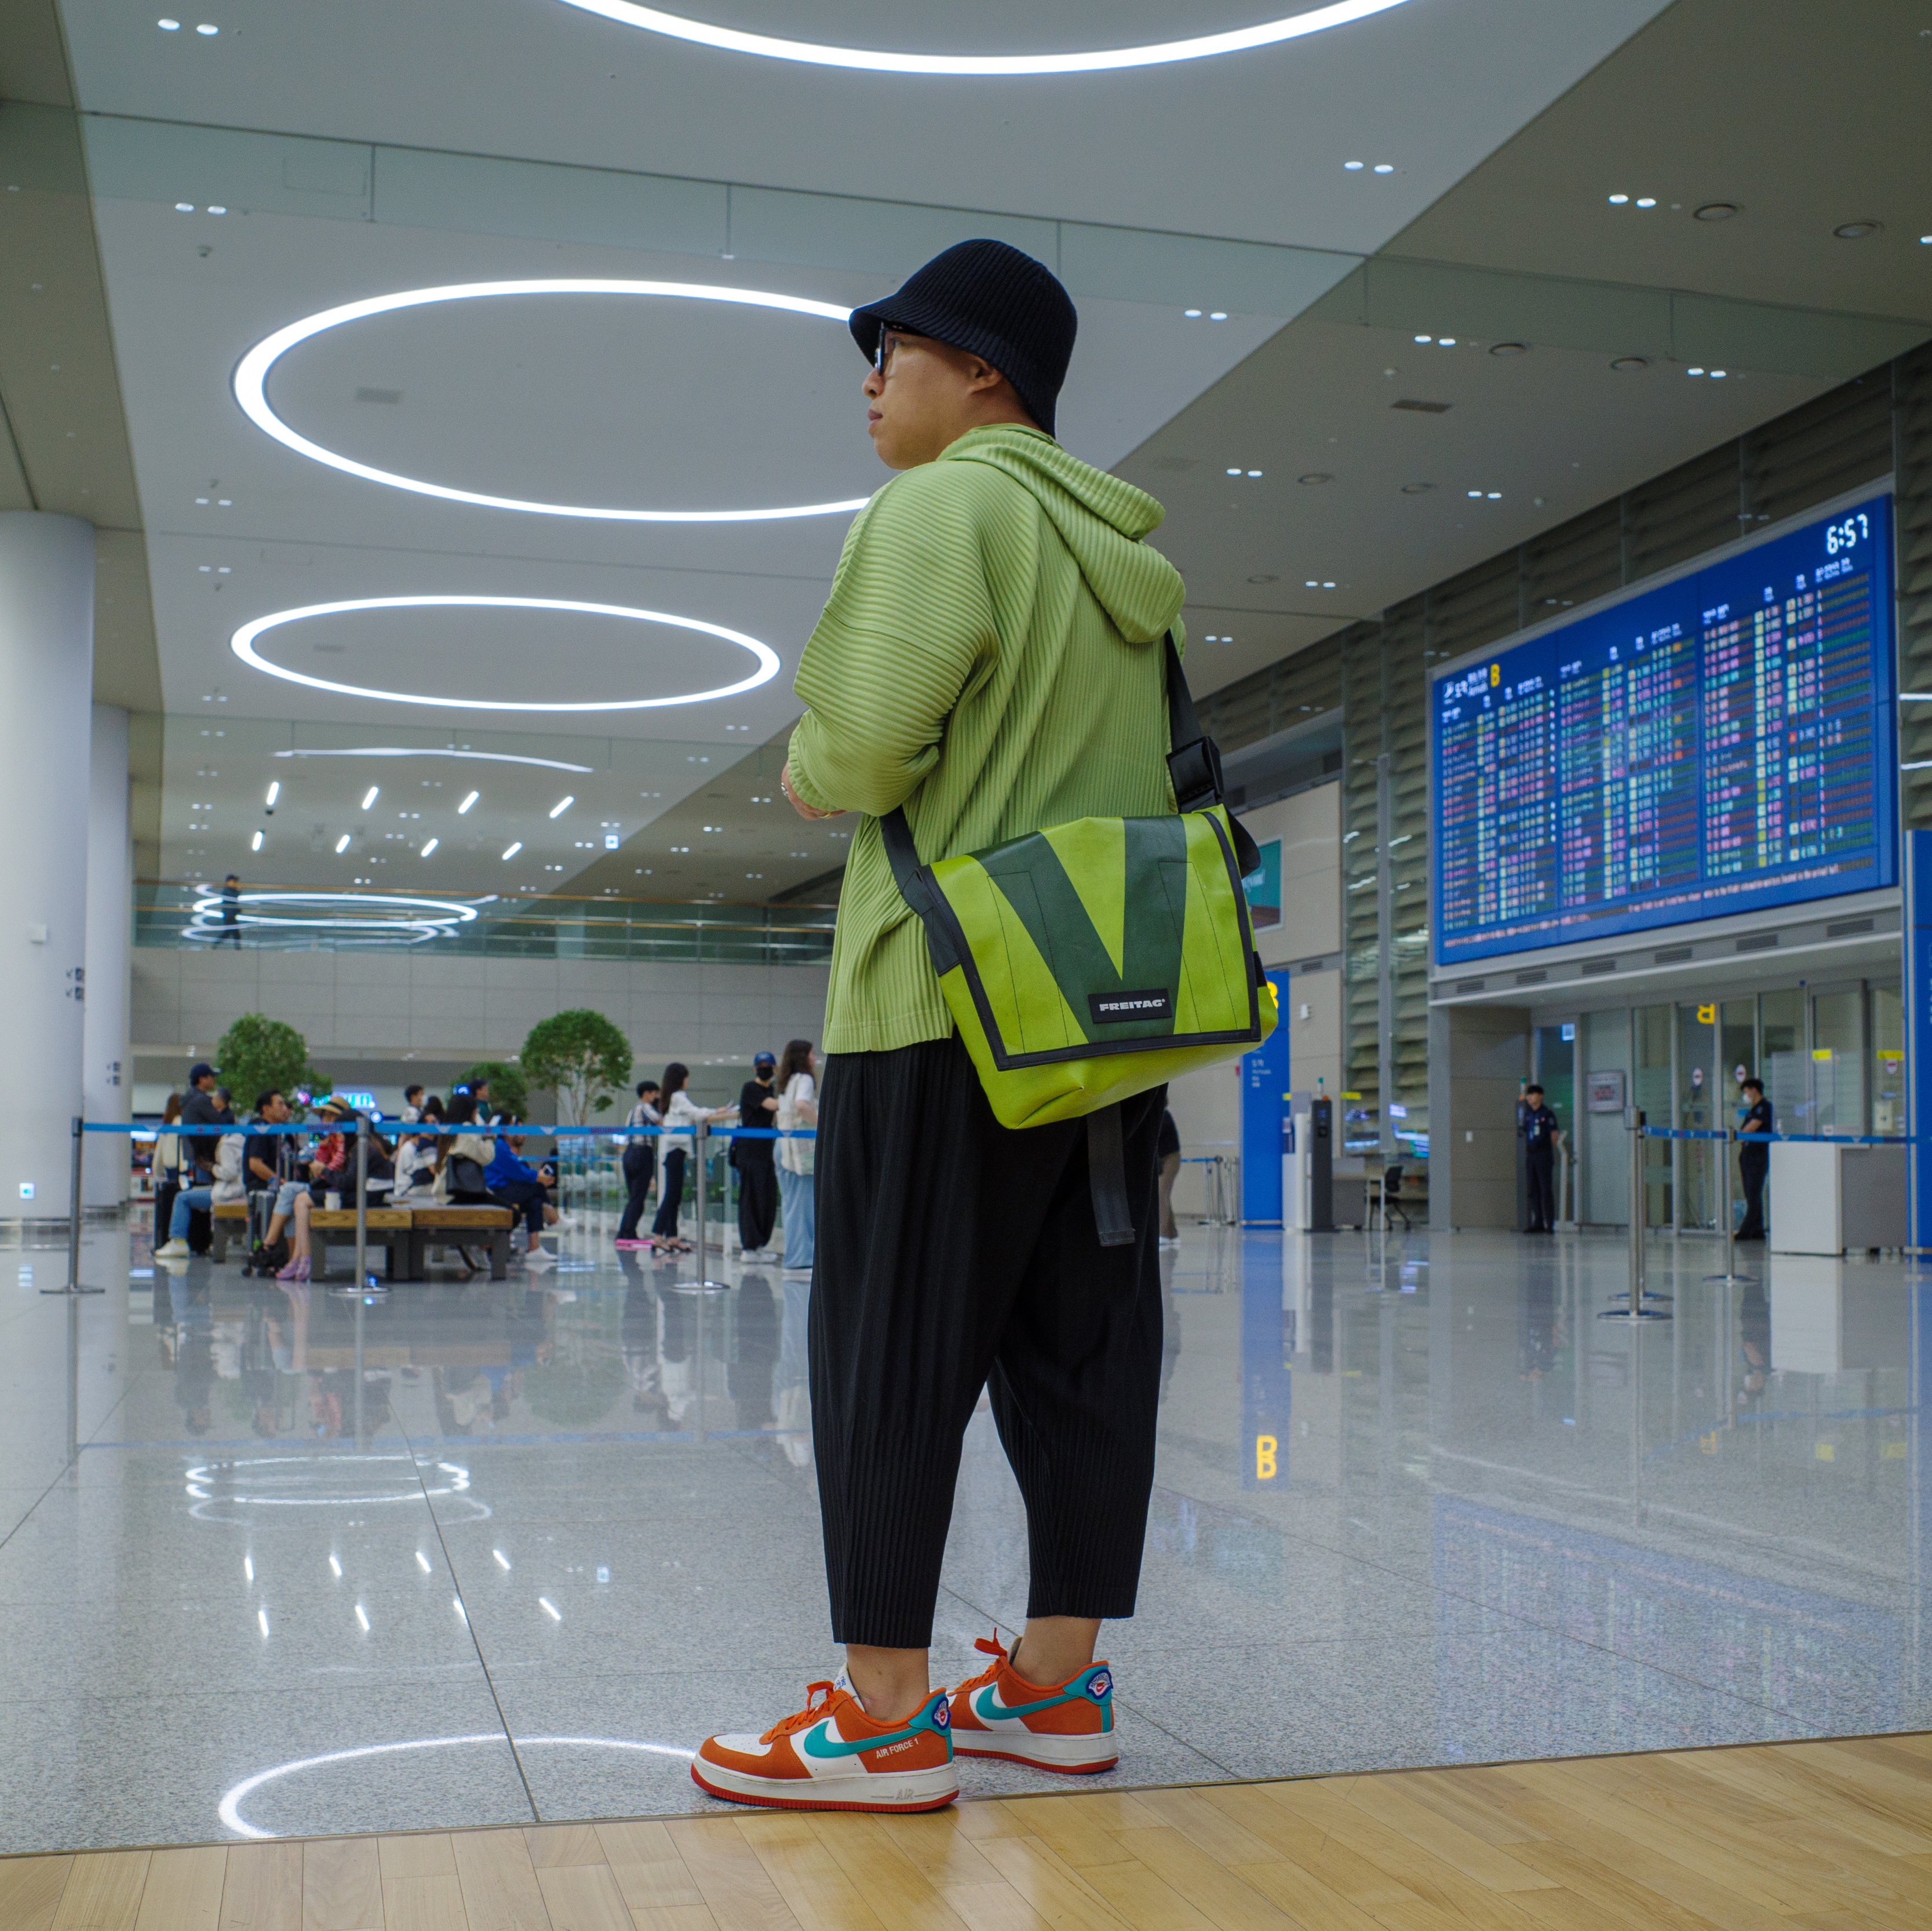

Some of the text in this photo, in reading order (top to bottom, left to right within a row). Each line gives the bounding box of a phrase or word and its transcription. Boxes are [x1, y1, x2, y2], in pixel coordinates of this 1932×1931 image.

[1827, 513, 1868, 554] 6:57
[1099, 999, 1163, 1012] FREITAG
[876, 1749, 889, 1759] AIR
[889, 1740, 913, 1754] FORCE
[895, 1788, 914, 1800] AIR
